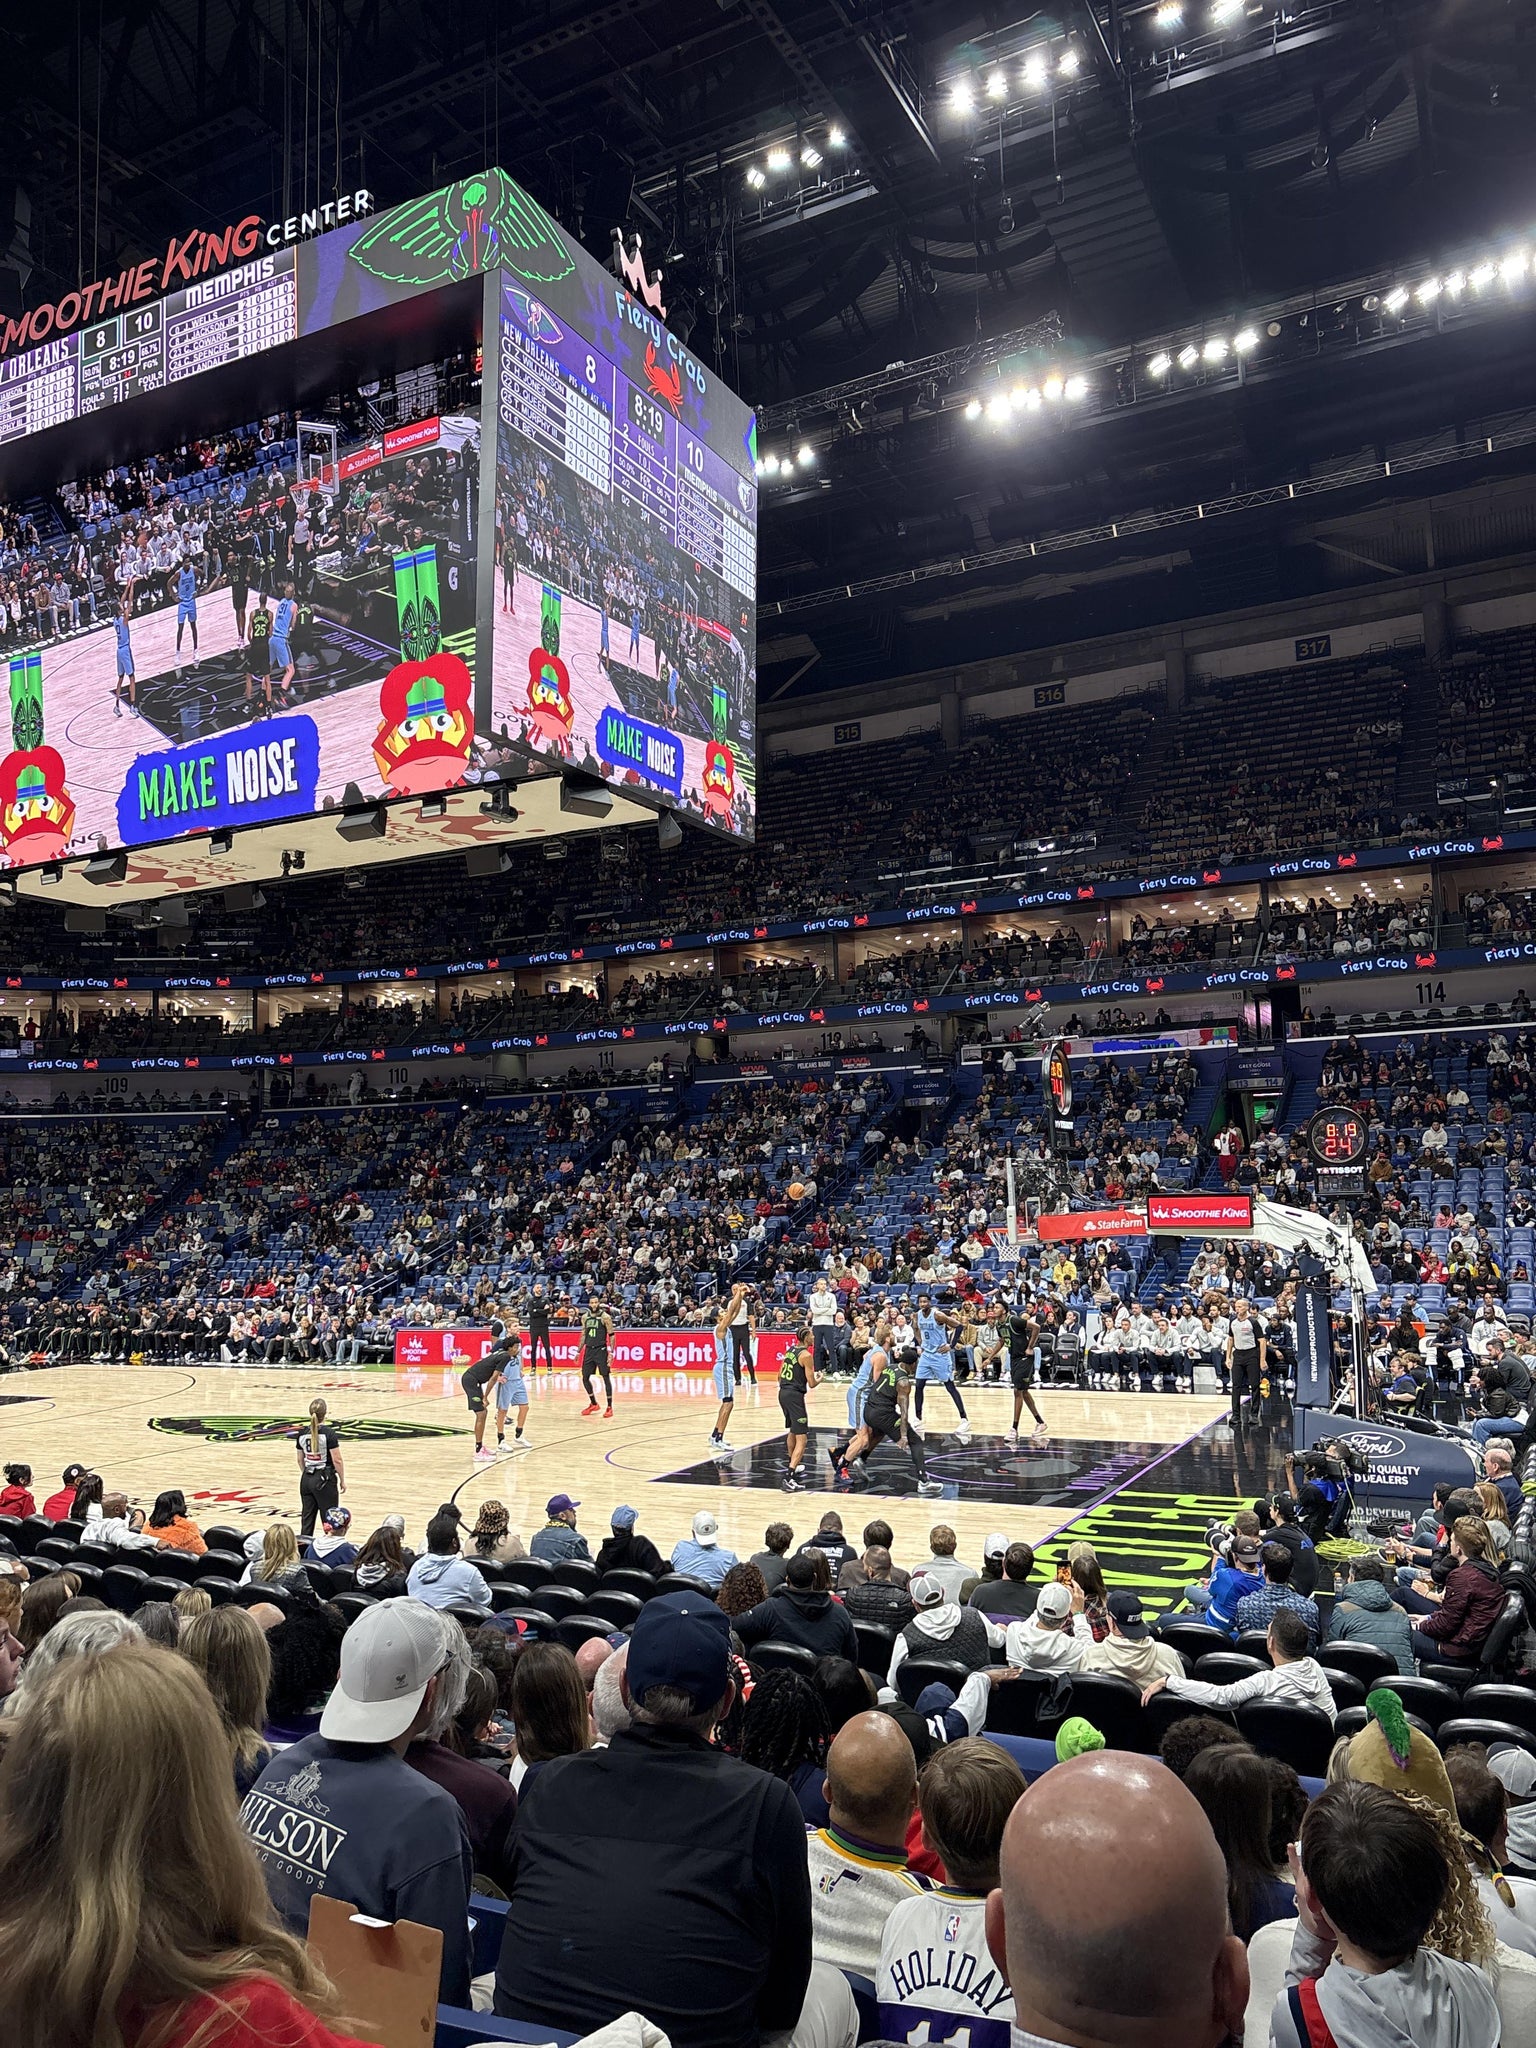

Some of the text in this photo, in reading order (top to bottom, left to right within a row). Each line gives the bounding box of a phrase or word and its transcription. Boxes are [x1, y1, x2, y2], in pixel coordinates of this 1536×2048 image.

[266, 189, 369, 246] CENTER
[185, 255, 275, 309] MEMPHIS
[135, 311, 153, 332] 10
[192, 311, 219, 326] WELLS
[96, 330, 106, 348] 8
[193, 332, 228, 349] COWARD
[615, 289, 661, 348] Fiery
[666, 333, 706, 394] Crab
[193, 342, 230, 361] SPENCER
[504, 319, 560, 377] NEW ORLEANS
[9, 337, 69, 380] ORLEANS
[109, 350, 135, 371] 8:19
[522, 354, 565, 395] WILLIAMSON
[585, 354, 596, 384] 8
[138, 371, 163, 386] FOULS
[522, 374, 546, 397] JONES
[81, 391, 105, 407] FOULS
[522, 390, 547, 414] QUEEN
[520, 404, 551, 433] MURPHY
[634, 394, 663, 433] 8:19
[522, 421, 537, 439] BEY
[637, 434, 655, 457] FOULS
[687, 440, 704, 473] 10
[684, 466, 718, 503] MEMPHIS
[1299, 640, 1328, 656] 317
[1036, 689, 1062, 703] 316
[836, 726, 859, 740] 315
[606, 715, 677, 778] MAKE NOISE
[138, 738, 299, 821] MAKE NOISE
[1409, 842, 1474, 859] Fiery Crab
[1270, 859, 1330, 875] Fiery Crab
[1139, 876, 1196, 891] Fiery Crab
[1018, 891, 1071, 906] Fiery Crab
[907, 906, 956, 920] Fiery Crab
[803, 919, 849, 932] Fiery Crab
[707, 931, 749, 943] Fiery Crab
[615, 944, 634, 954] Fiery
[529, 954, 547, 964] Fiery
[1341, 958, 1407, 974] Fiery Crab
[358, 971, 378, 979] Fiery
[447, 964, 464, 973] Fiery
[62, 979, 84, 988] Fiery
[165, 978, 187, 987] Fiery
[265, 976, 285, 985] Fiery
[1207, 970, 1269, 986] Fiery Crab
[1081, 982, 1139, 996] Fiery Crab
[1415, 981, 1446, 1004] 114
[965, 993, 1018, 1007] Fiery Crab
[858, 1003, 907, 1017] Fiery Crab
[665, 1021, 708, 1034] Fiery Crab
[758, 1013, 804, 1026] Fiery Crab
[492, 1040, 511, 1049] Fiery
[576, 1032, 596, 1042] Fiery
[323, 1053, 344, 1062] Fiery
[412, 1047, 431, 1056] Fiery
[598, 1051, 614, 1068] 111
[28, 1061, 52, 1069] Fiery
[132, 1059, 154, 1068] Fiery
[232, 1057, 252, 1066] Fiery
[388, 1068, 408, 1084] 110
[104, 1078, 128, 1093] 109
[1326, 1123, 1357, 1137] 8:19
[1325, 1138, 1352, 1156] 24
[1170, 1208, 1221, 1218] SMOOTHIE
[650, 1342, 712, 1367] Right
[781, 1364, 794, 1380] 25
[1349, 1434, 1393, 1455] Ford
[1378, 1465, 1420, 1475] QUALITY
[1363, 1473, 1409, 1485] DEALERS
[277, 1859, 325, 1890] GOODS
[890, 1947, 1013, 2016] HOLIDAY
